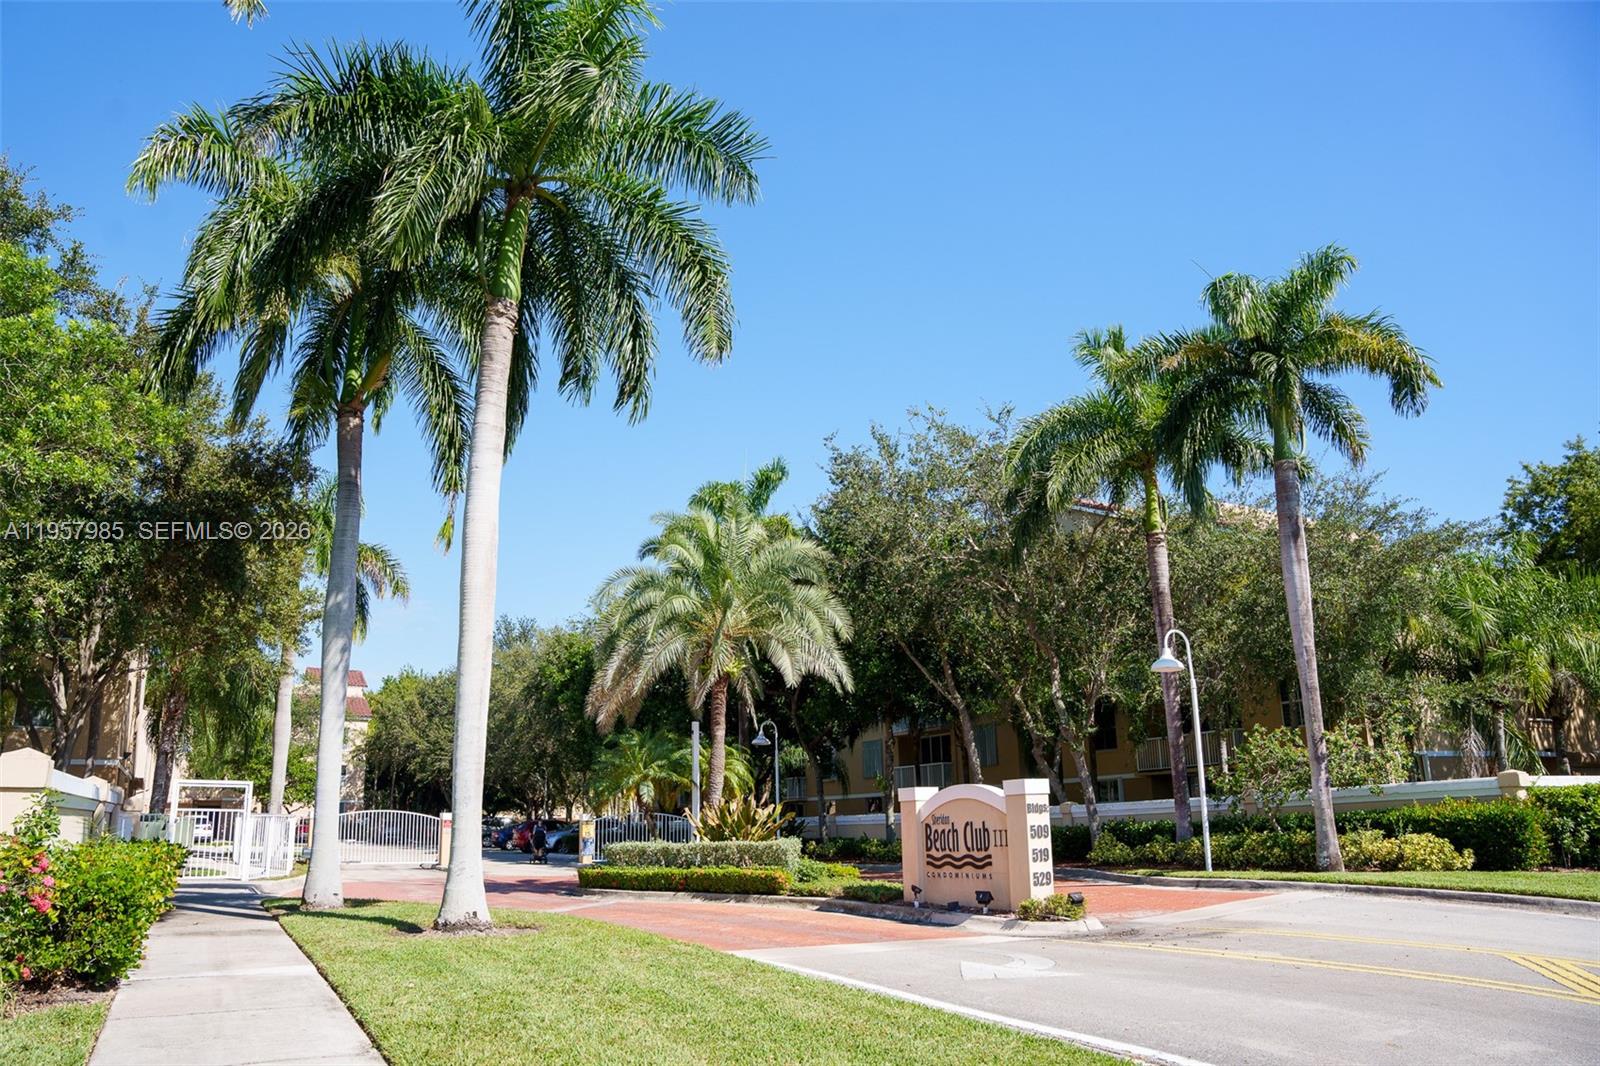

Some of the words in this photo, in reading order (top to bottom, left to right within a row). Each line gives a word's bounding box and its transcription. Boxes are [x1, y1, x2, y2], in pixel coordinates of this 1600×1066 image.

[925, 822, 959, 852] Beach
[963, 821, 990, 852] Club
[993, 829, 1008, 847] III
[1030, 824, 1049, 839] 509
[1032, 848, 1049, 862] 519
[927, 871, 993, 880] CONDOMINIUMS
[1033, 872, 1051, 887] 529
